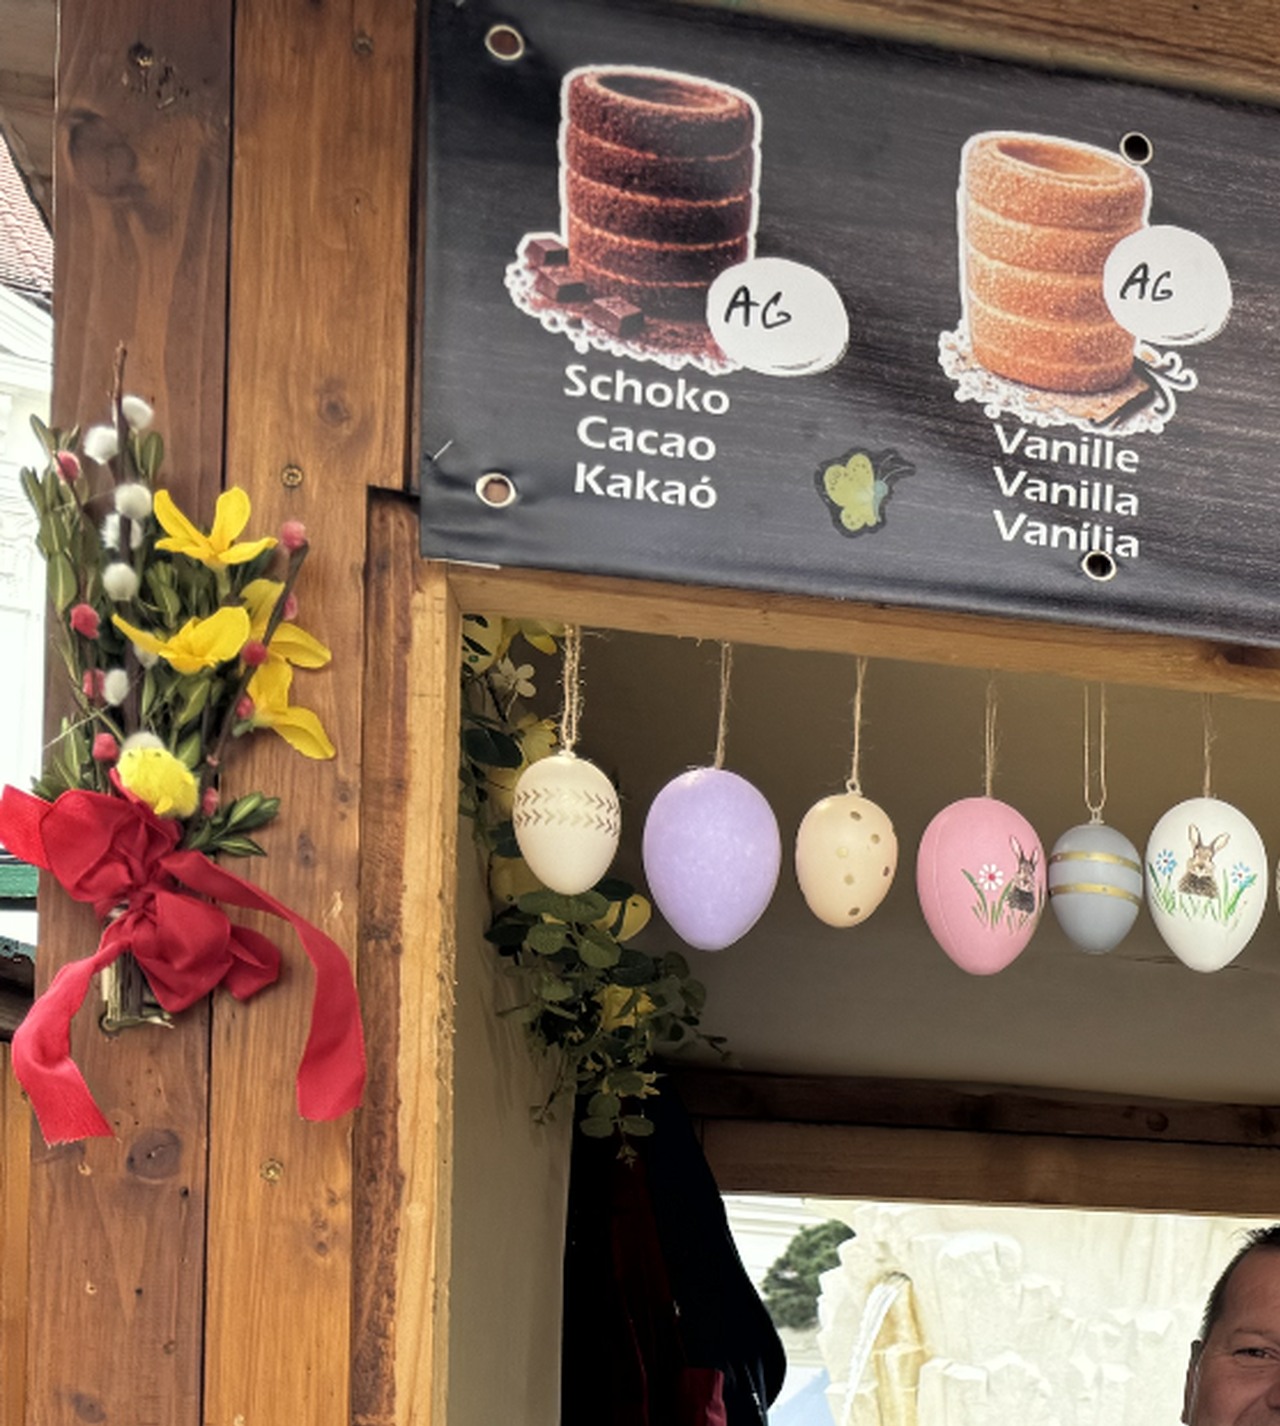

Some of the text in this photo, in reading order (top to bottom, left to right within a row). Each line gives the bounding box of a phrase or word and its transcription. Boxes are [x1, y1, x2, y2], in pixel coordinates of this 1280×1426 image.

[1119, 263, 1174, 302] AG
[723, 287, 792, 330] AG
[563, 364, 731, 415] Schoko
[576, 415, 716, 462] Cacao
[993, 424, 1141, 473] Vanille
[573, 463, 718, 509] Kakaó
[993, 468, 1141, 517] Vanilla
